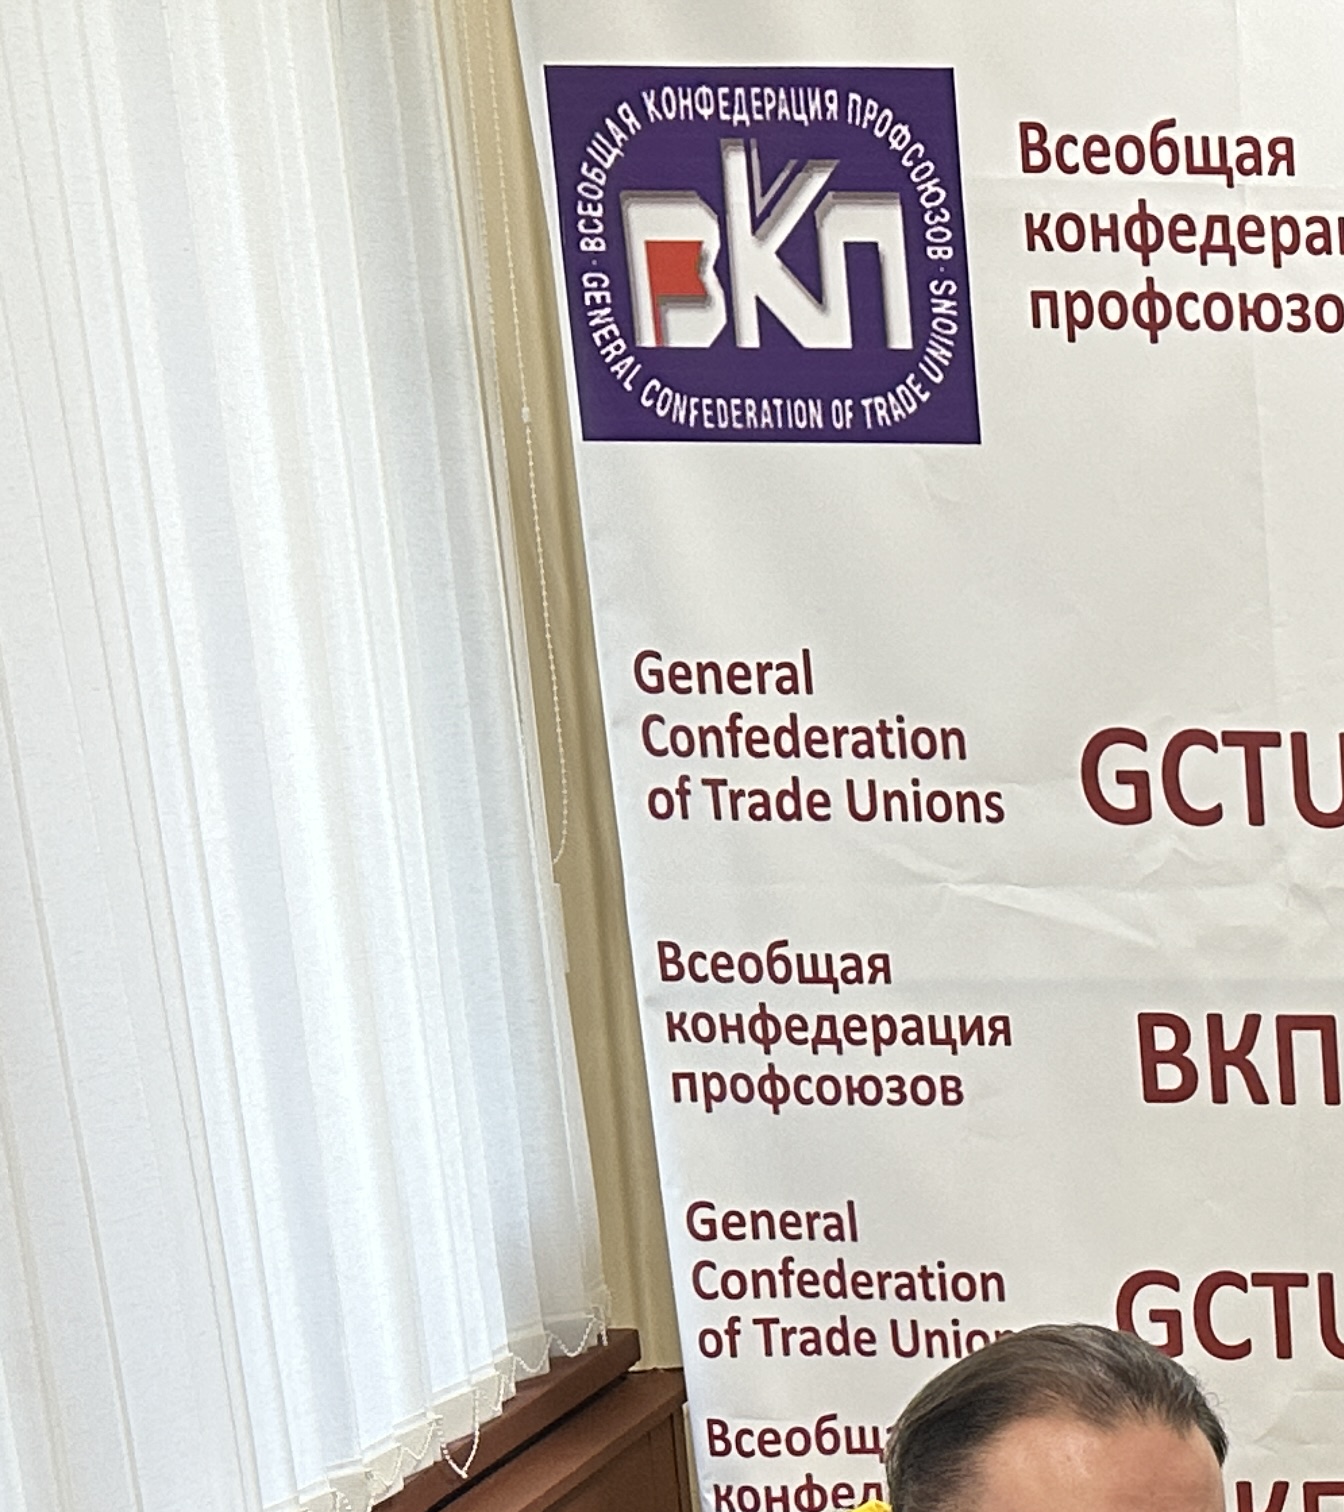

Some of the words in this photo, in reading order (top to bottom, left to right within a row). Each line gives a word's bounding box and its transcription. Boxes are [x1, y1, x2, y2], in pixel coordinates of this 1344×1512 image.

[577, 102, 641, 251] ВСЕОБЩАЯ
[641, 85, 839, 128] КОНФЕДЕРАЦИЯ
[847, 92, 952, 260] ПРОФСОЮЗОВ
[1018, 117, 1296, 189] Всеобщая
[619, 138, 914, 349] ВКП
[581, 271, 644, 392] GENERAL
[640, 377, 824, 430] CONFEDERATION
[831, 399, 855, 429] OF
[861, 372, 930, 430] TRADE
[918, 279, 959, 384] UNIONS
[634, 649, 813, 695] General
[641, 712, 965, 760] Confederation
[647, 774, 690, 821] of
[702, 777, 831, 822] Trade
[846, 780, 1005, 823] Unions
[657, 939, 891, 994] Всеобщая
[666, 1003, 1013, 1055] конфедерация
[1136, 1011, 1342, 1106] ВКП
[671, 1065, 964, 1114] профсоюзов
[685, 1200, 858, 1242] General
[691, 1256, 1005, 1302] Confederation
[698, 1315, 740, 1359] of
[752, 1316, 877, 1358] Trade
[890, 1318, 1014, 1359] Unio
[706, 1412, 891, 1460] Всеобщ
